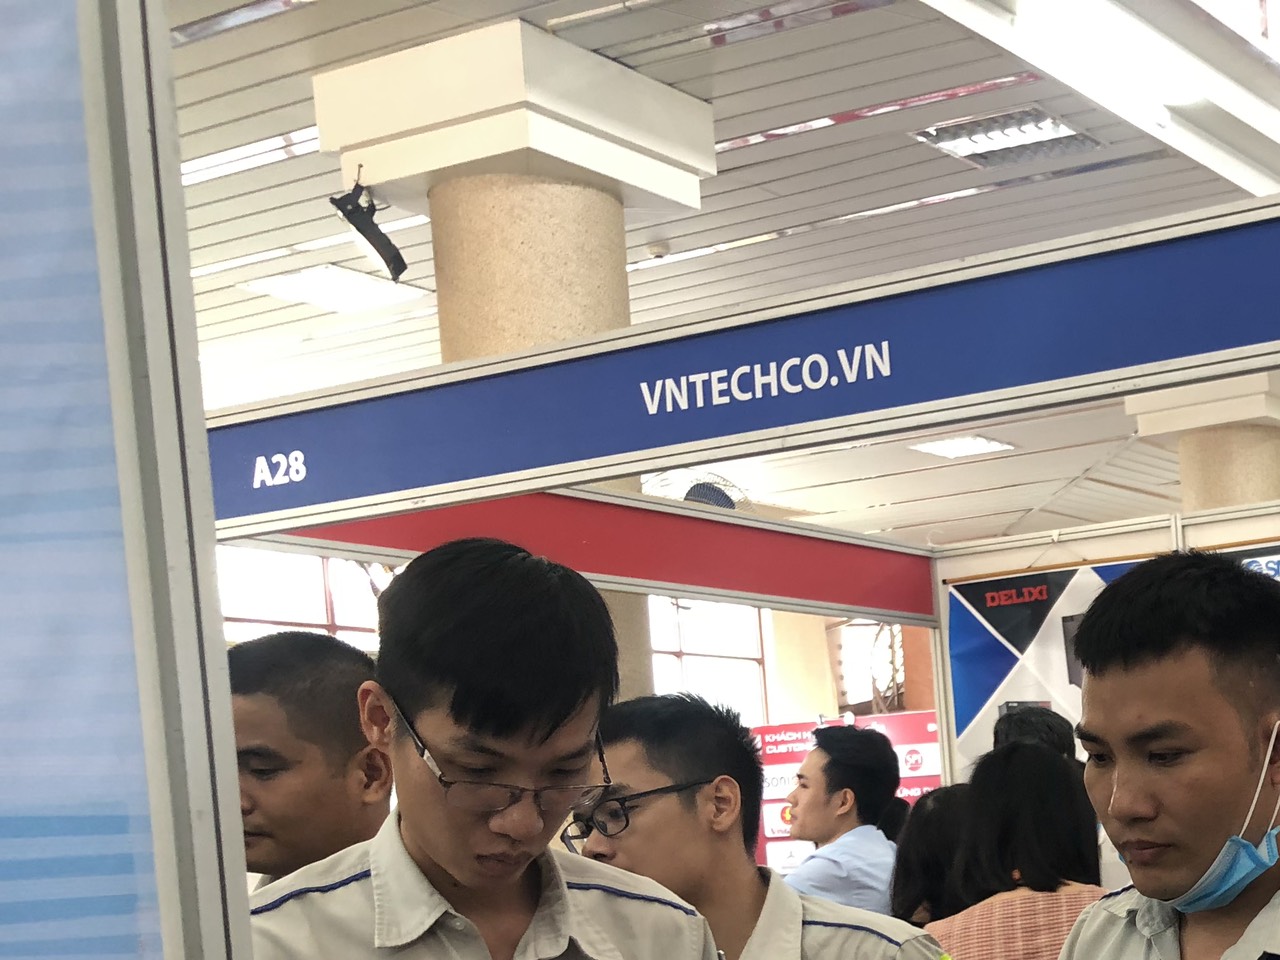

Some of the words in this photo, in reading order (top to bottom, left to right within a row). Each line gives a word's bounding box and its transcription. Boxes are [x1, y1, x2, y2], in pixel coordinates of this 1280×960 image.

[639, 340, 892, 415] VNTECHCO.VN
[252, 450, 307, 490] A28
[984, 585, 1049, 608] DELIXI
